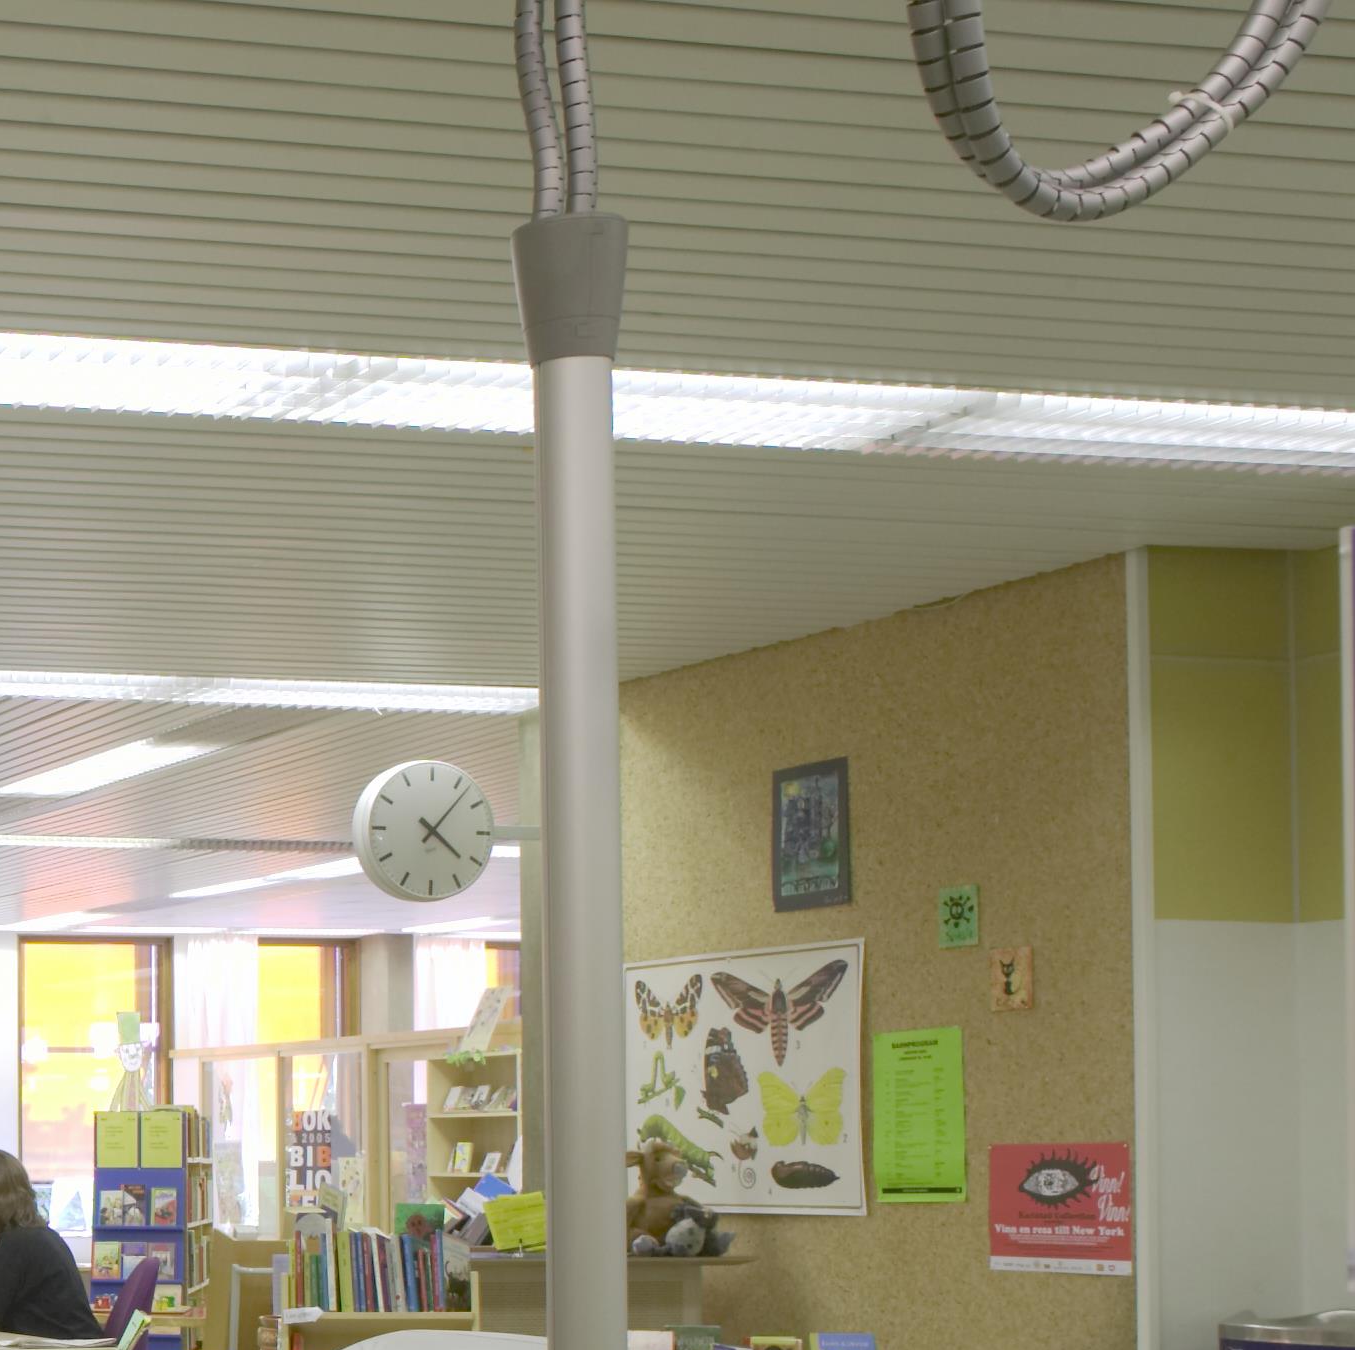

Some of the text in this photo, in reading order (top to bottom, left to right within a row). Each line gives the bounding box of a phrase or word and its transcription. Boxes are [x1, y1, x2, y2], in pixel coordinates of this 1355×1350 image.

[292, 1110, 332, 1132] BOK
[301, 1132, 332, 1143] 2005
[290, 1145, 332, 1168] BIB
[1097, 1194, 1131, 1223] Vinn!
[994, 1223, 1017, 1234] Vinn
[1019, 1226, 1030, 1234] en
[1054, 1225, 1070, 1235] till
[1072, 1225, 1096, 1235] New
[1098, 1226, 1125, 1237] York
